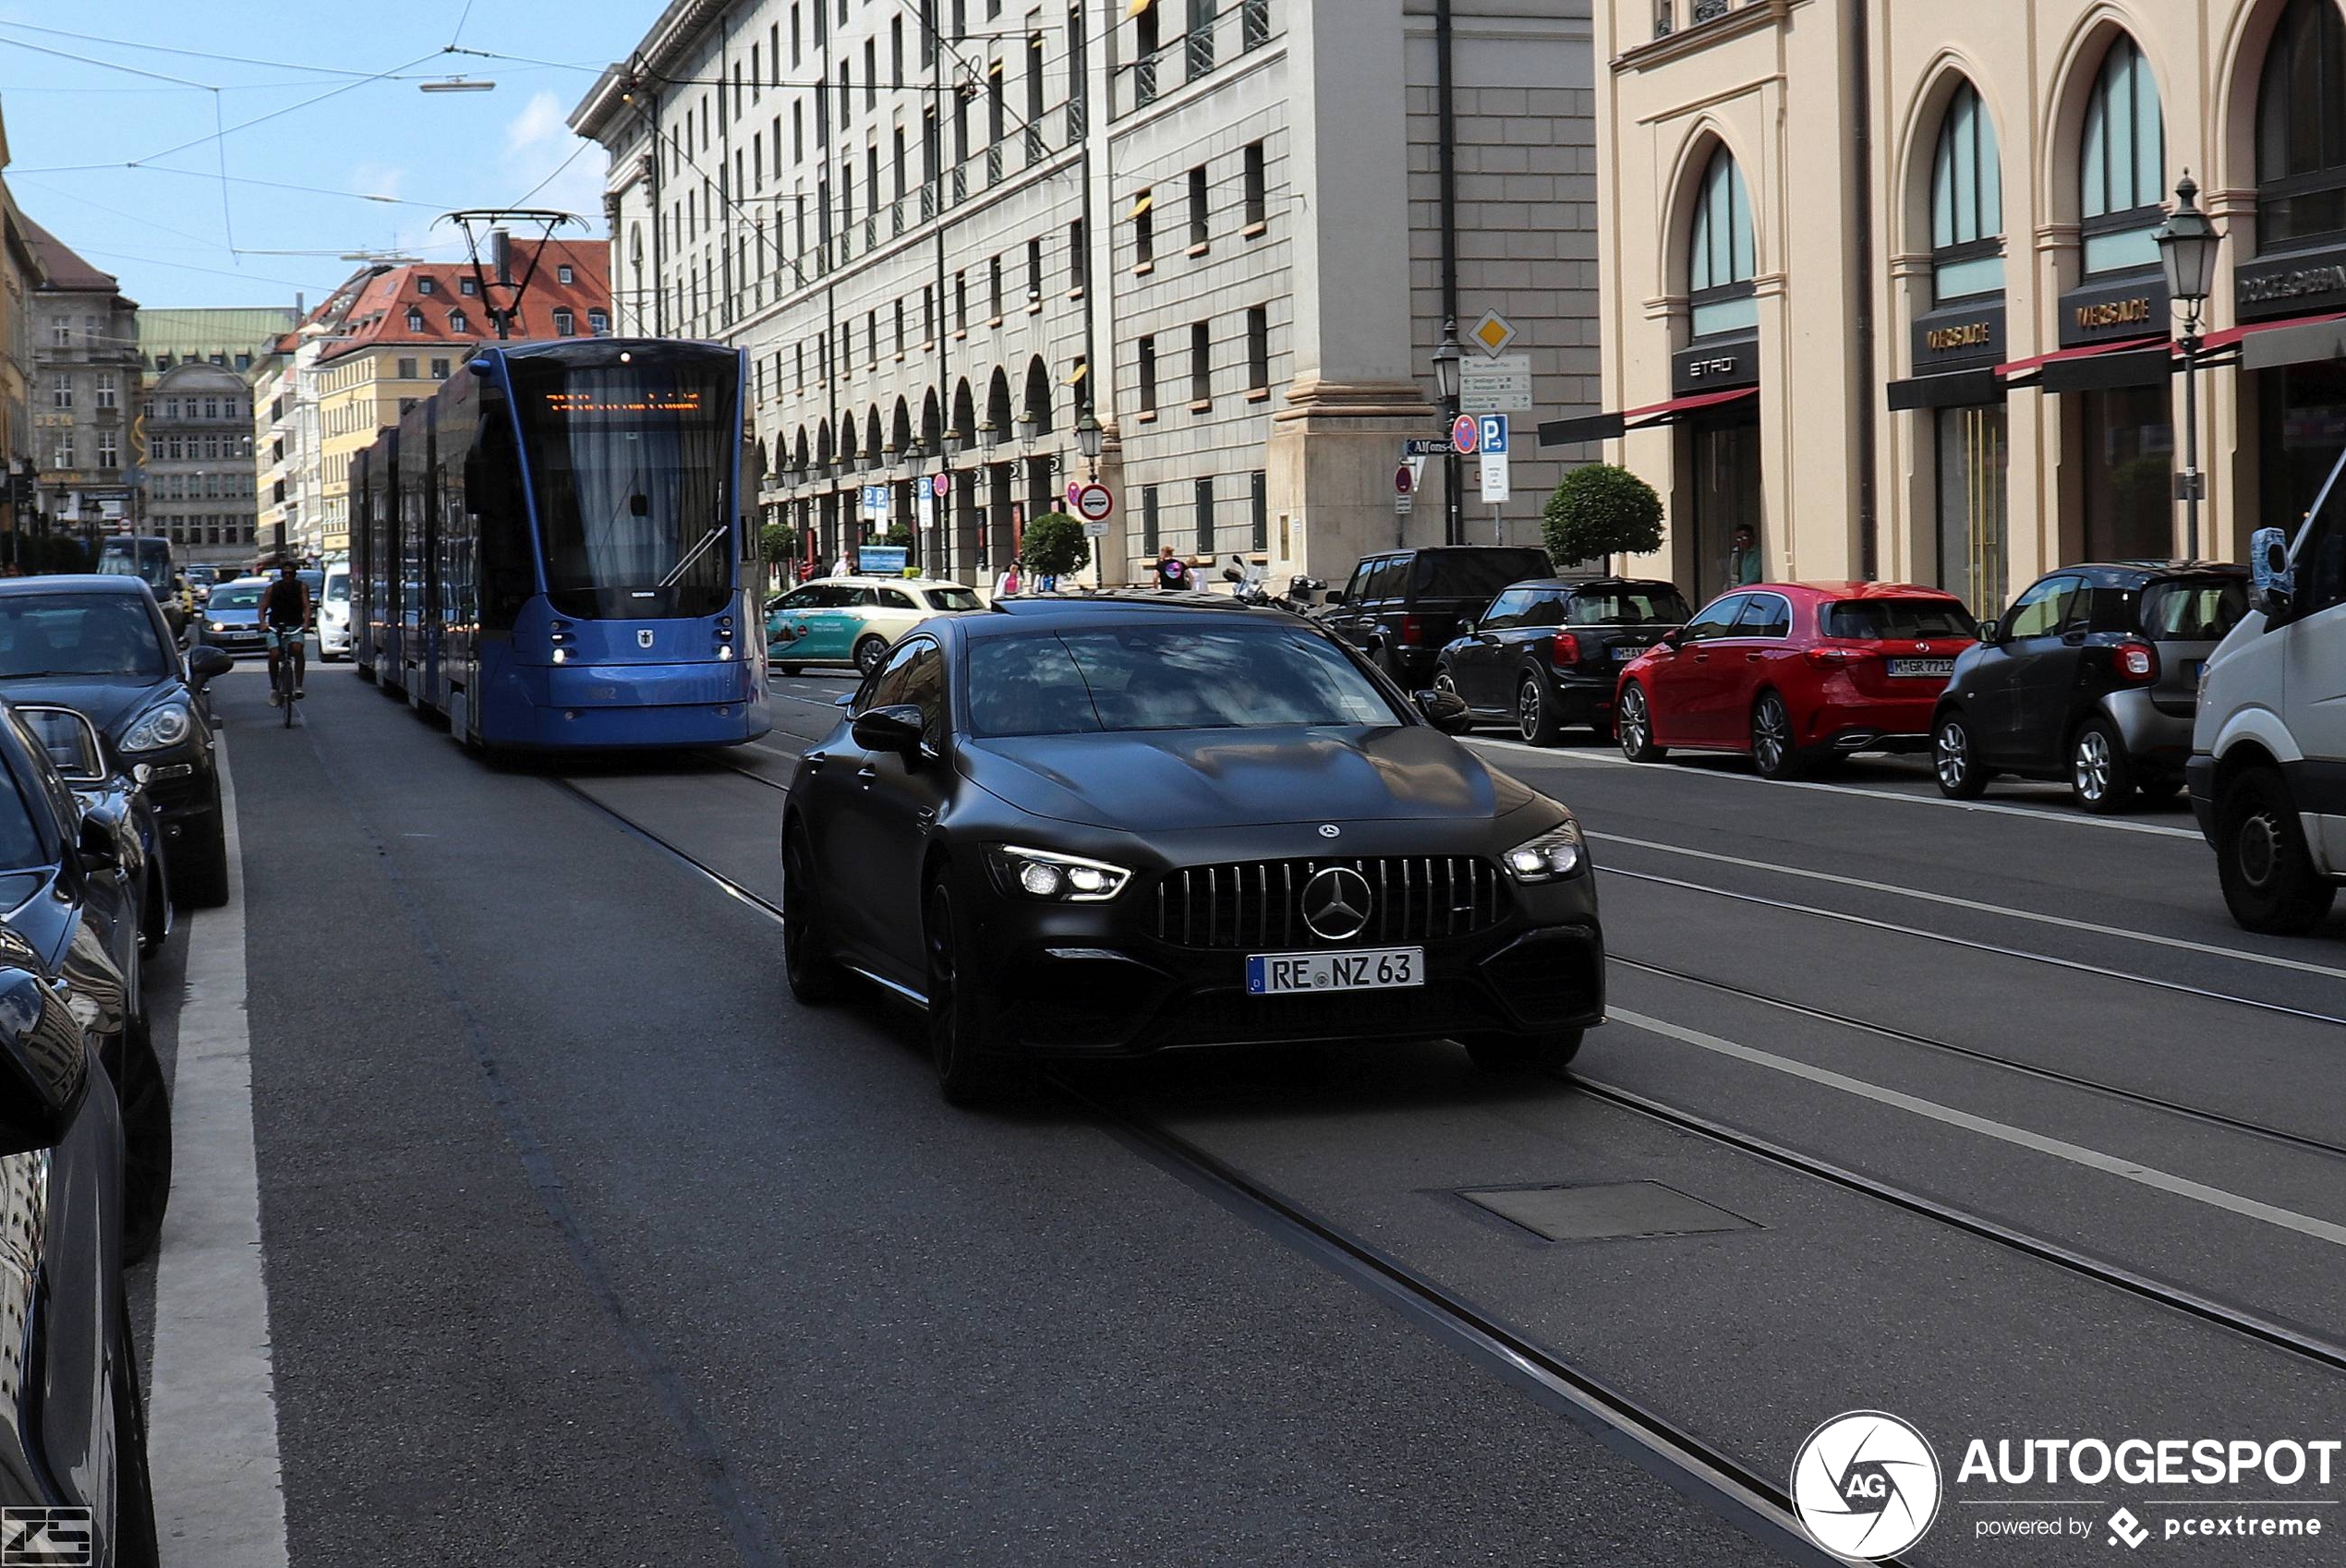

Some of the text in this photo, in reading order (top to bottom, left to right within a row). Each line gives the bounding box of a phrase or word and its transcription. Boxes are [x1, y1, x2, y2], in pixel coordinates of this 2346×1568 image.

[2075, 297, 2150, 328] VERSACE
[1927, 322, 1990, 350] VERSACE
[1689, 356, 1734, 377] ETRO
[1483, 420, 1500, 450] P
[1895, 660, 1953, 672] M GR 7712
[1272, 959, 1311, 989] RE
[1333, 957, 1370, 985] NZ
[1377, 954, 1410, 983] 63
